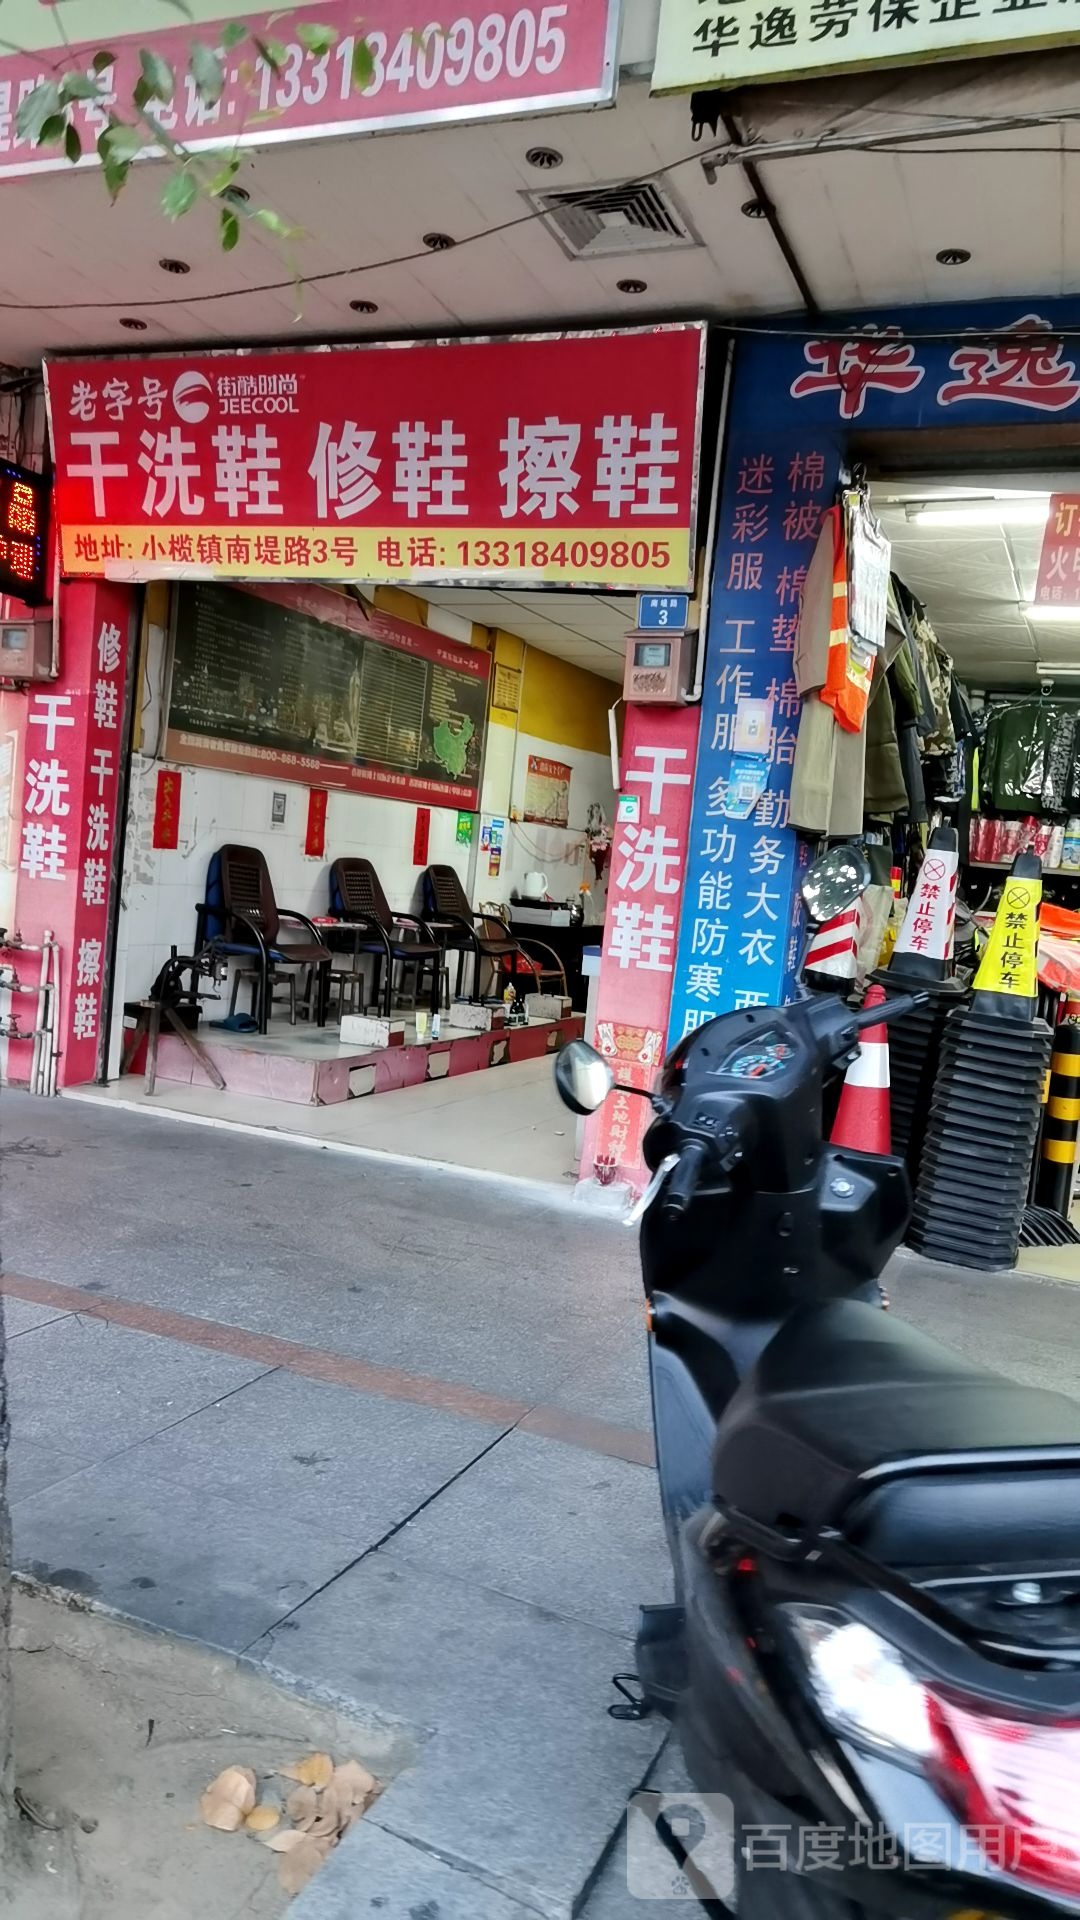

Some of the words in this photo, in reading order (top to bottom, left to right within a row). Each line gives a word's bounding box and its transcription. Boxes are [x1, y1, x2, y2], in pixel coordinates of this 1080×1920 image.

[69, 377, 168, 421] 老字号
[217, 374, 298, 396] 街酷时尚
[219, 397, 300, 415] JEECOOL
[66, 424, 283, 518] 干洗鞋
[308, 419, 470, 520] 修鞋
[498, 413, 679, 520] 擦鞋
[782, 451, 824, 541] 棉被
[74, 533, 132, 561] 地址:
[141, 534, 358, 567] 小榄镇南堤路3号
[377, 536, 445, 567] 电话:
[457, 540, 671, 568] 13318409805
[726, 453, 774, 591] 迷彩服
[1055, 502, 1080, 537] 订
[1046, 545, 1080, 580] 火
[658, 609, 669, 625] 3
[93, 621, 121, 729] 修鞋
[21, 694, 75, 881] 干洗鞋
[82, 748, 114, 905] 干洗鞋
[607, 745, 691, 973] 干洗鞋
[739, 789, 790, 966] 勤务大衣
[909, 883, 941, 950] 禁止停车
[999, 912, 1028, 989] 禁止停车
[73, 938, 102, 1040] 擦鞋
